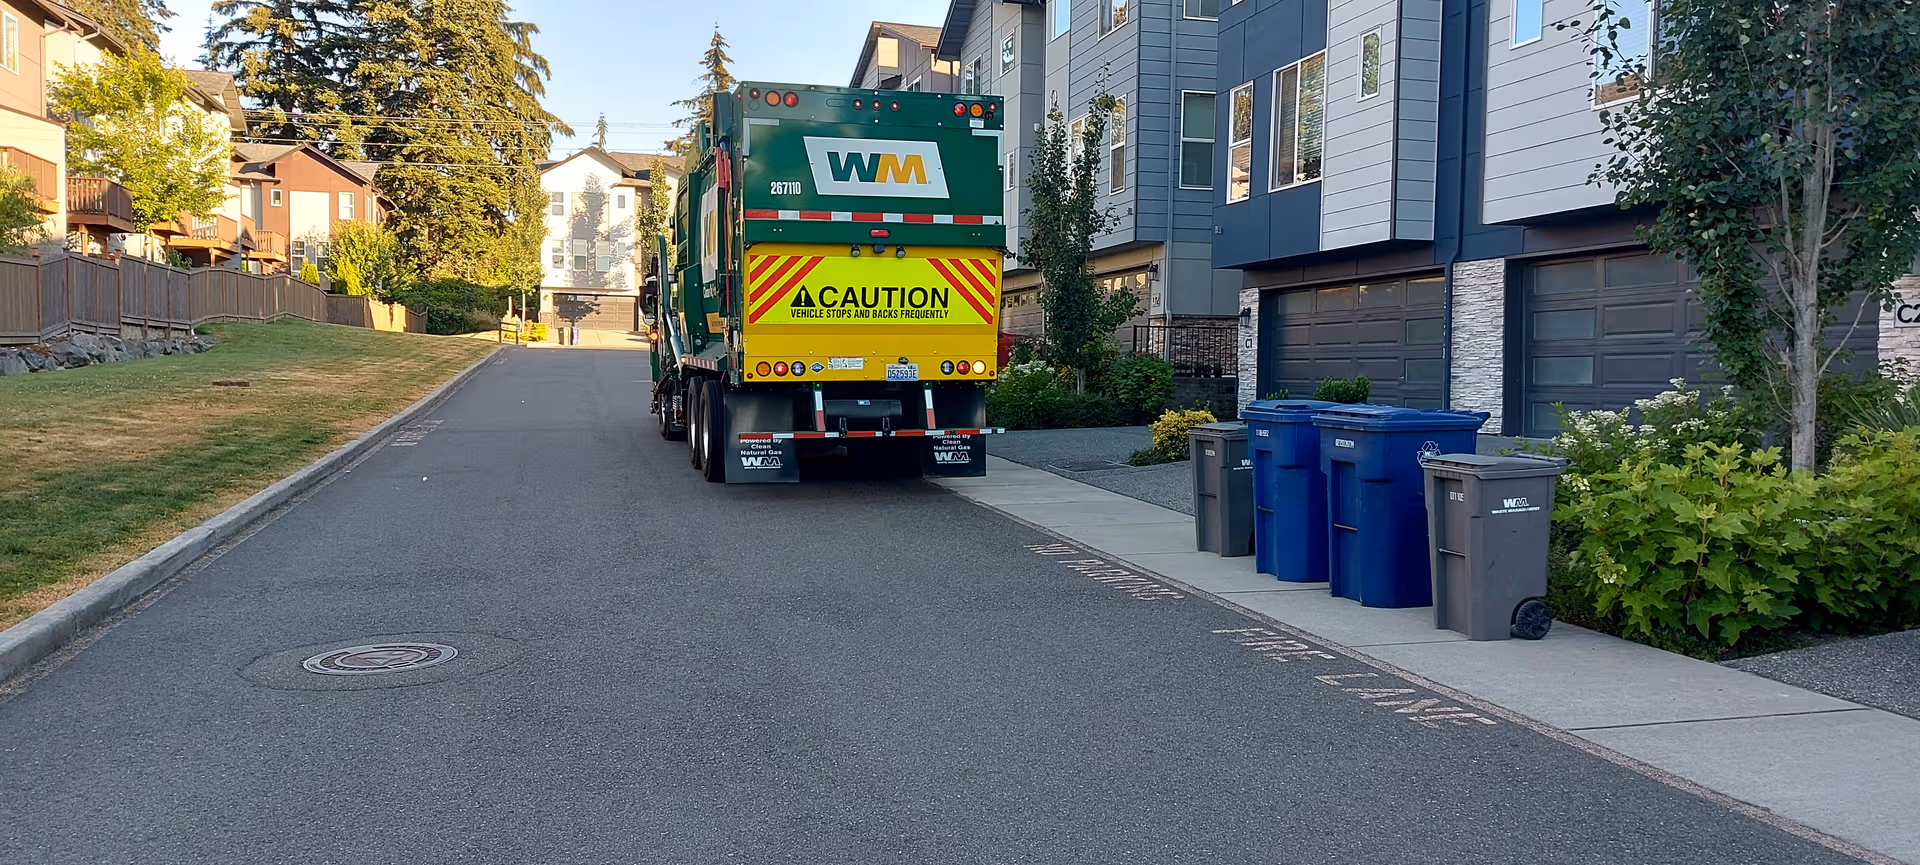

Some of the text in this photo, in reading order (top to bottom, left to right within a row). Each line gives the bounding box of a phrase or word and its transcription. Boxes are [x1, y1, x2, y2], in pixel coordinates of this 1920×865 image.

[826, 151, 928, 185] WM
[770, 181, 801, 195] 267110
[818, 286, 949, 309] CAUTION
[791, 309, 950, 320] VEHICLE STOPS AND BACKS FREQUENTLY
[741, 456, 781, 467] WM
[934, 451, 970, 461] WM
[1503, 497, 1530, 508] WM
[1314, 672, 1498, 729] LANE
